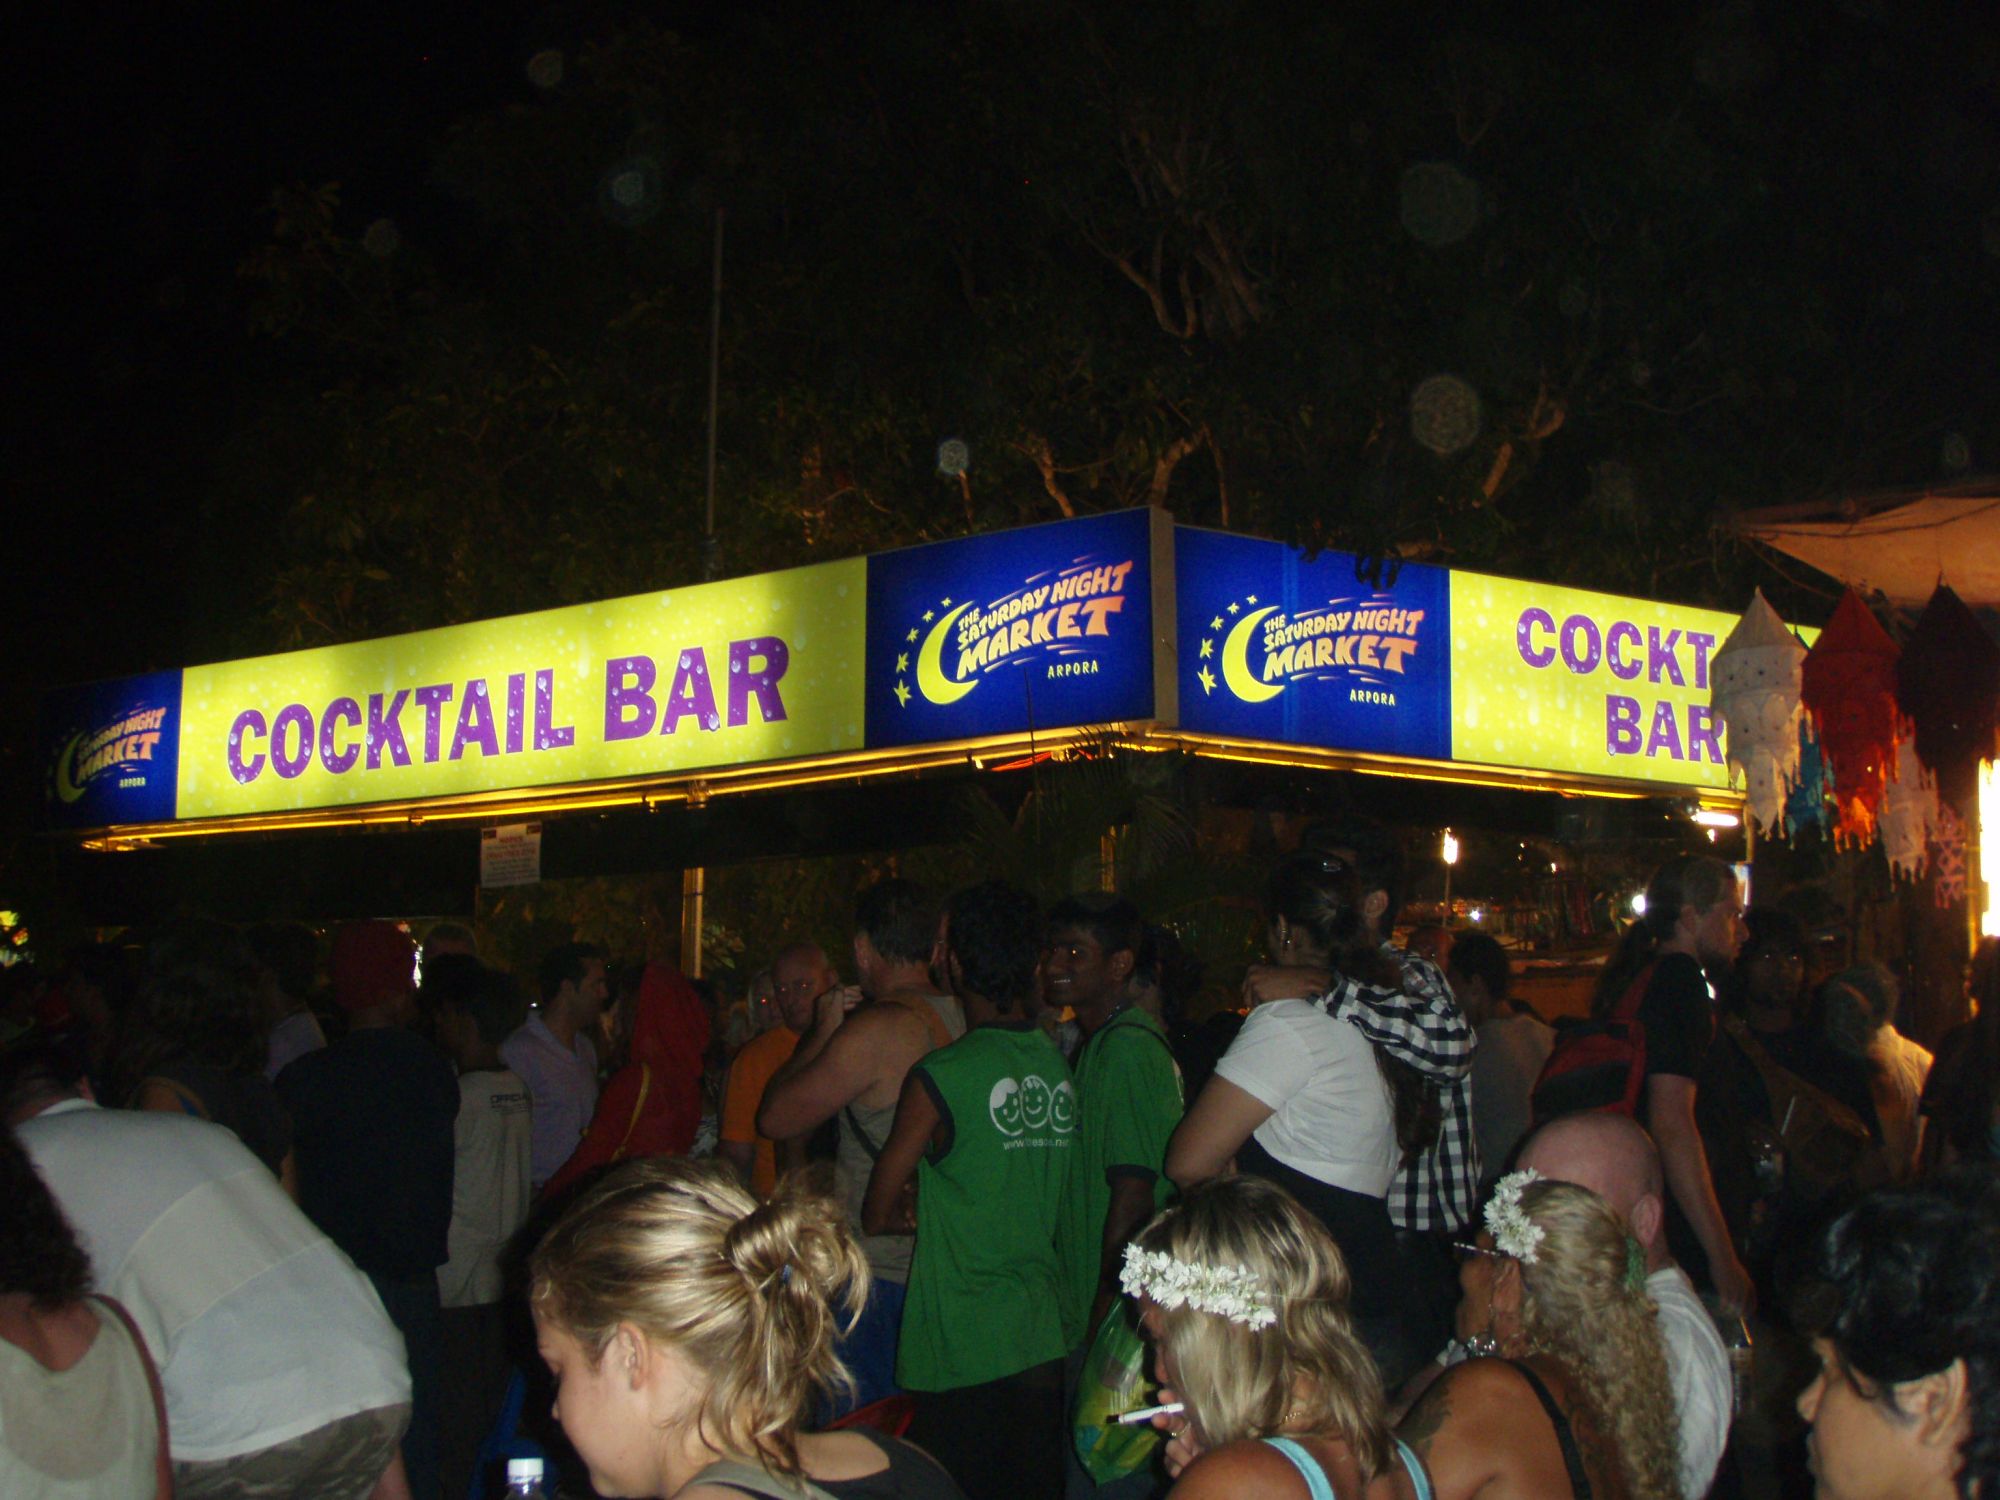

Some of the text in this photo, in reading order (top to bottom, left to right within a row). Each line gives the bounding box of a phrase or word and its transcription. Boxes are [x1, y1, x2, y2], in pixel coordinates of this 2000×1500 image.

[957, 560, 1133, 650] SATURDAY NIGHT
[958, 607, 980, 631] THE
[1264, 614, 1286, 633] THE
[956, 595, 1125, 681] MARKET
[1264, 608, 1425, 652] SATURDAY NIGHT
[1516, 607, 1715, 689] COCKT
[1047, 660, 1099, 679] ARPORA
[1263, 635, 1418, 682] MARKET
[124, 707, 166, 733] NIGHT
[228, 636, 789, 784] COCKTAIL BAR
[1350, 689, 1396, 706] ARPORA
[1606, 693, 1725, 765] BAR
[76, 732, 160, 784] MARKET
